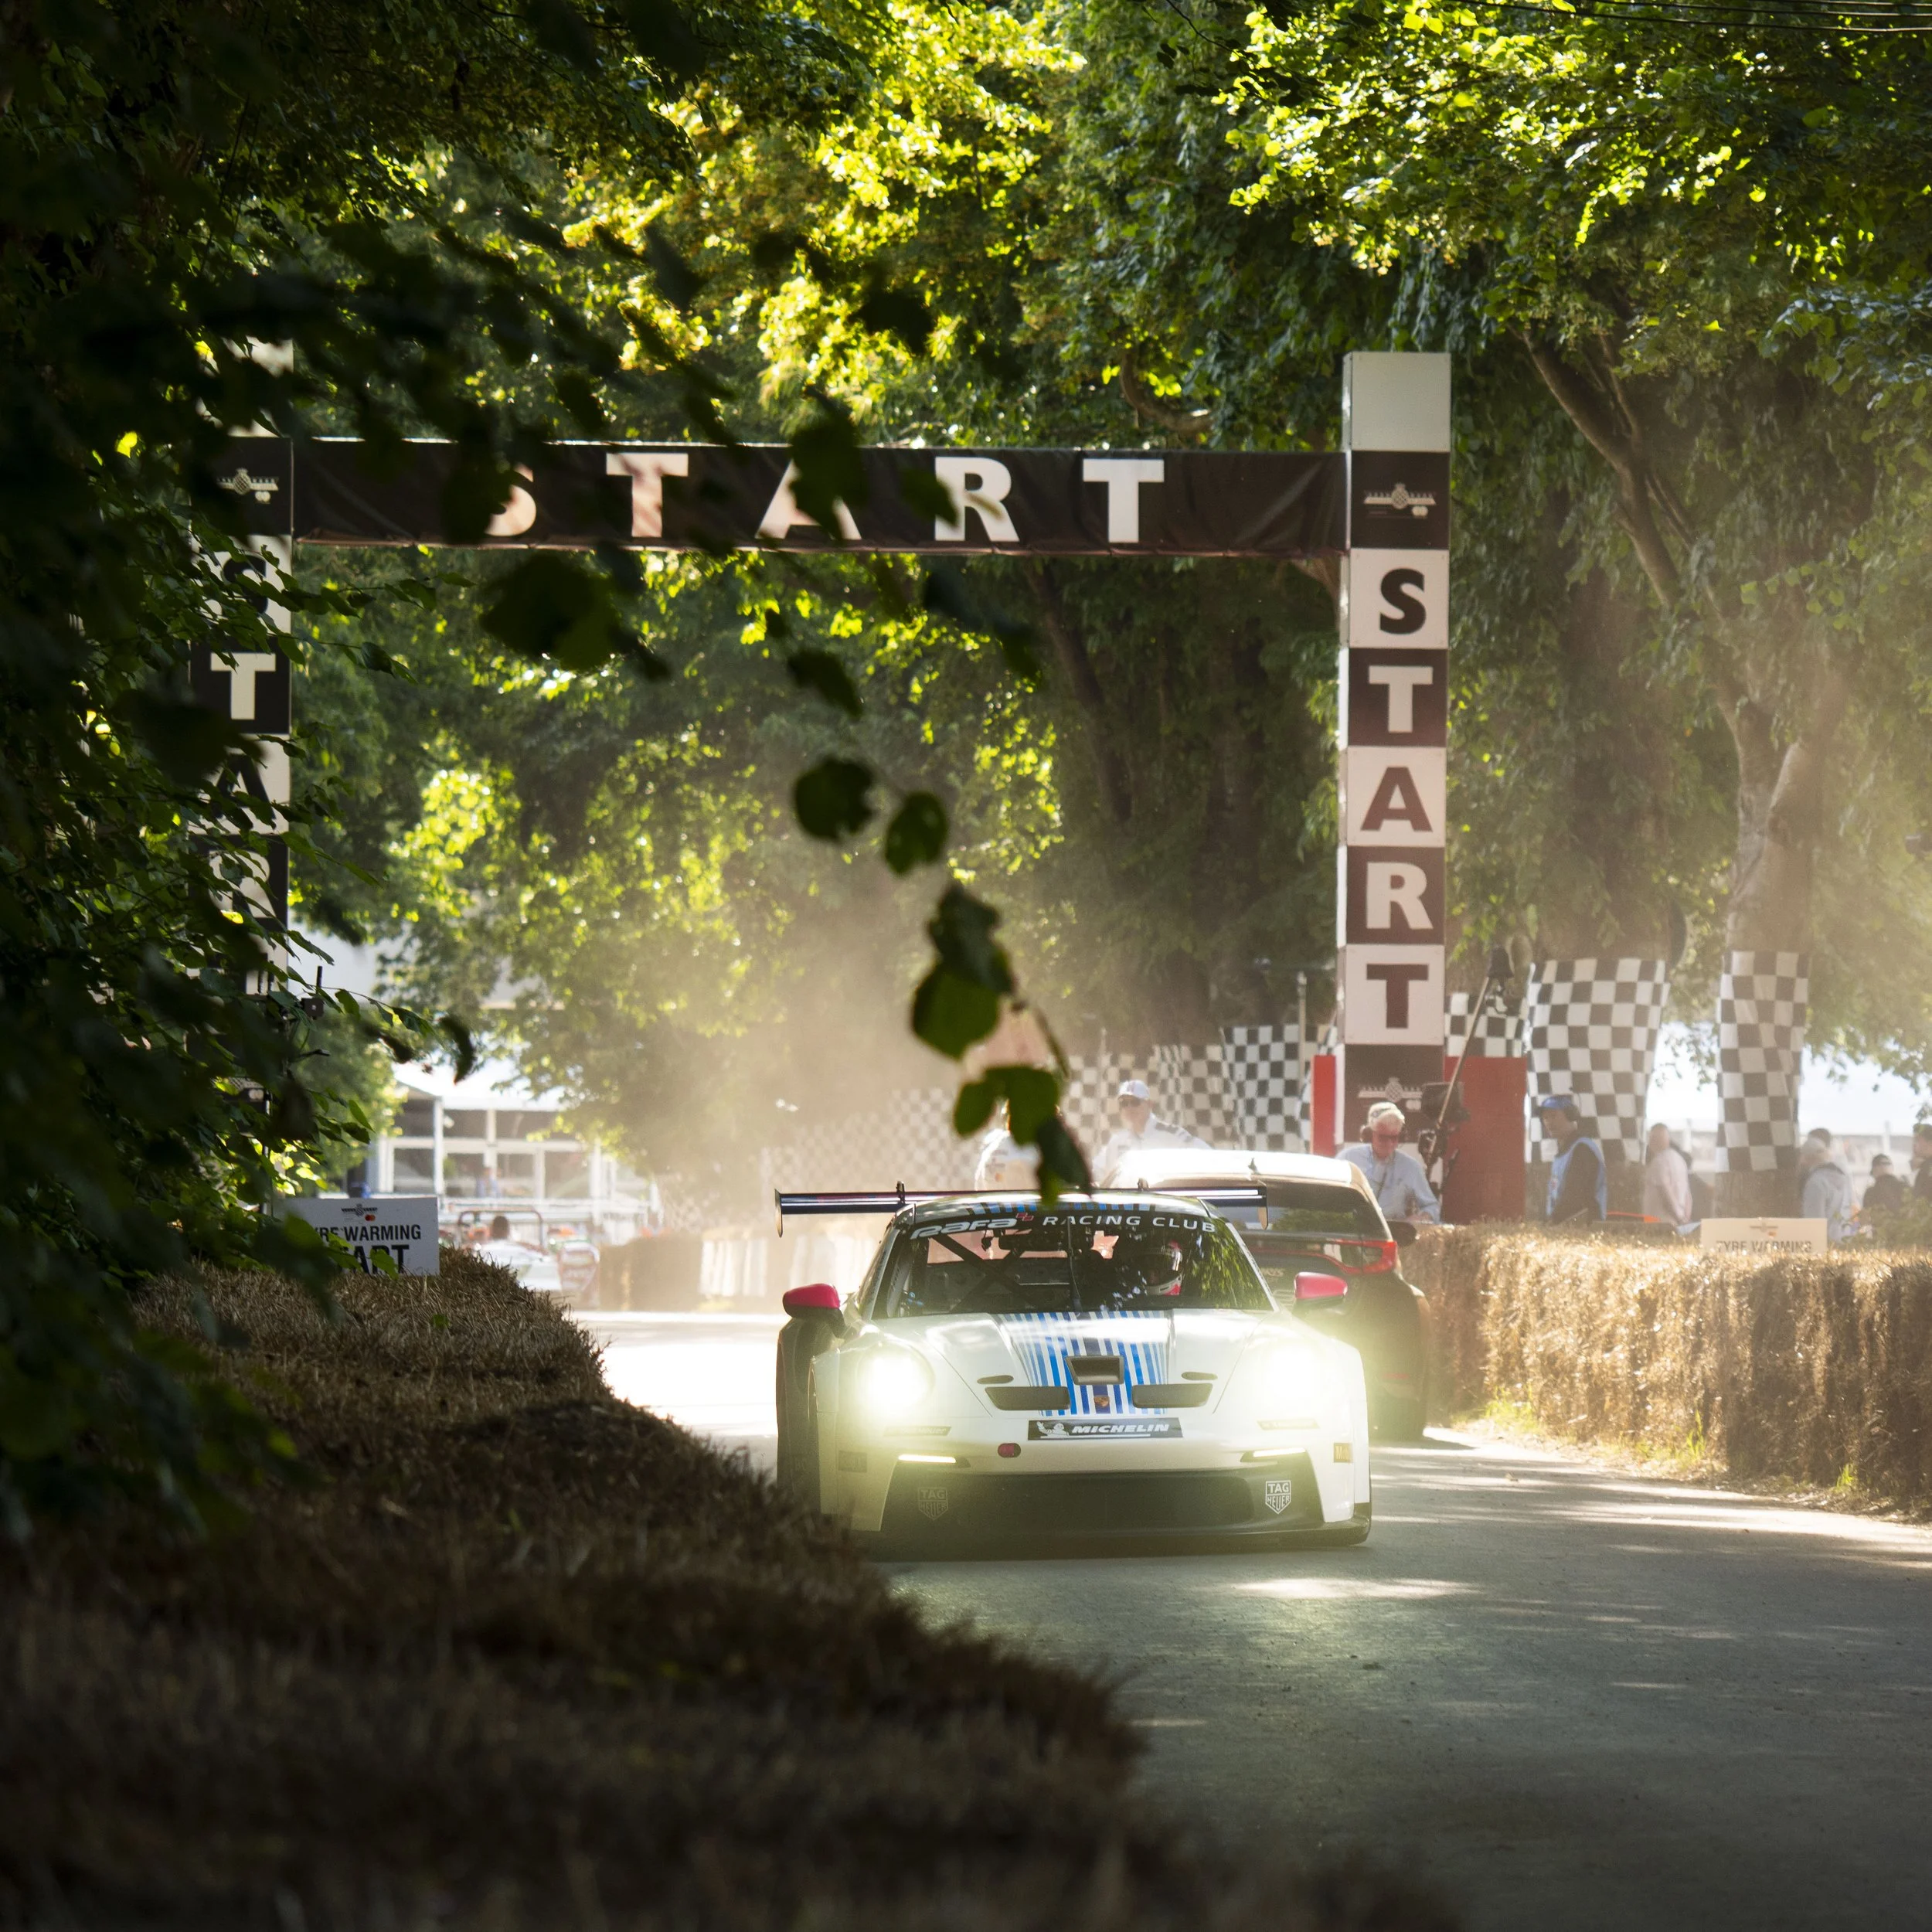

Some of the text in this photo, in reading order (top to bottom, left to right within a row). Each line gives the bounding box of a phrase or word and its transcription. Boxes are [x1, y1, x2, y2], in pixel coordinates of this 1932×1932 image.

[1360, 568, 1434, 1029] START
[344, 1224, 421, 1241] WARMING
[1043, 1216, 1141, 1226] RACING
[1152, 1217, 1216, 1233] CLUB
[1072, 1423, 1169, 1434] MICHELIN
[920, 1489, 945, 1499] TAG
[1268, 1482, 1290, 1493] TAG
[1267, 1495, 1290, 1511] HEUER
